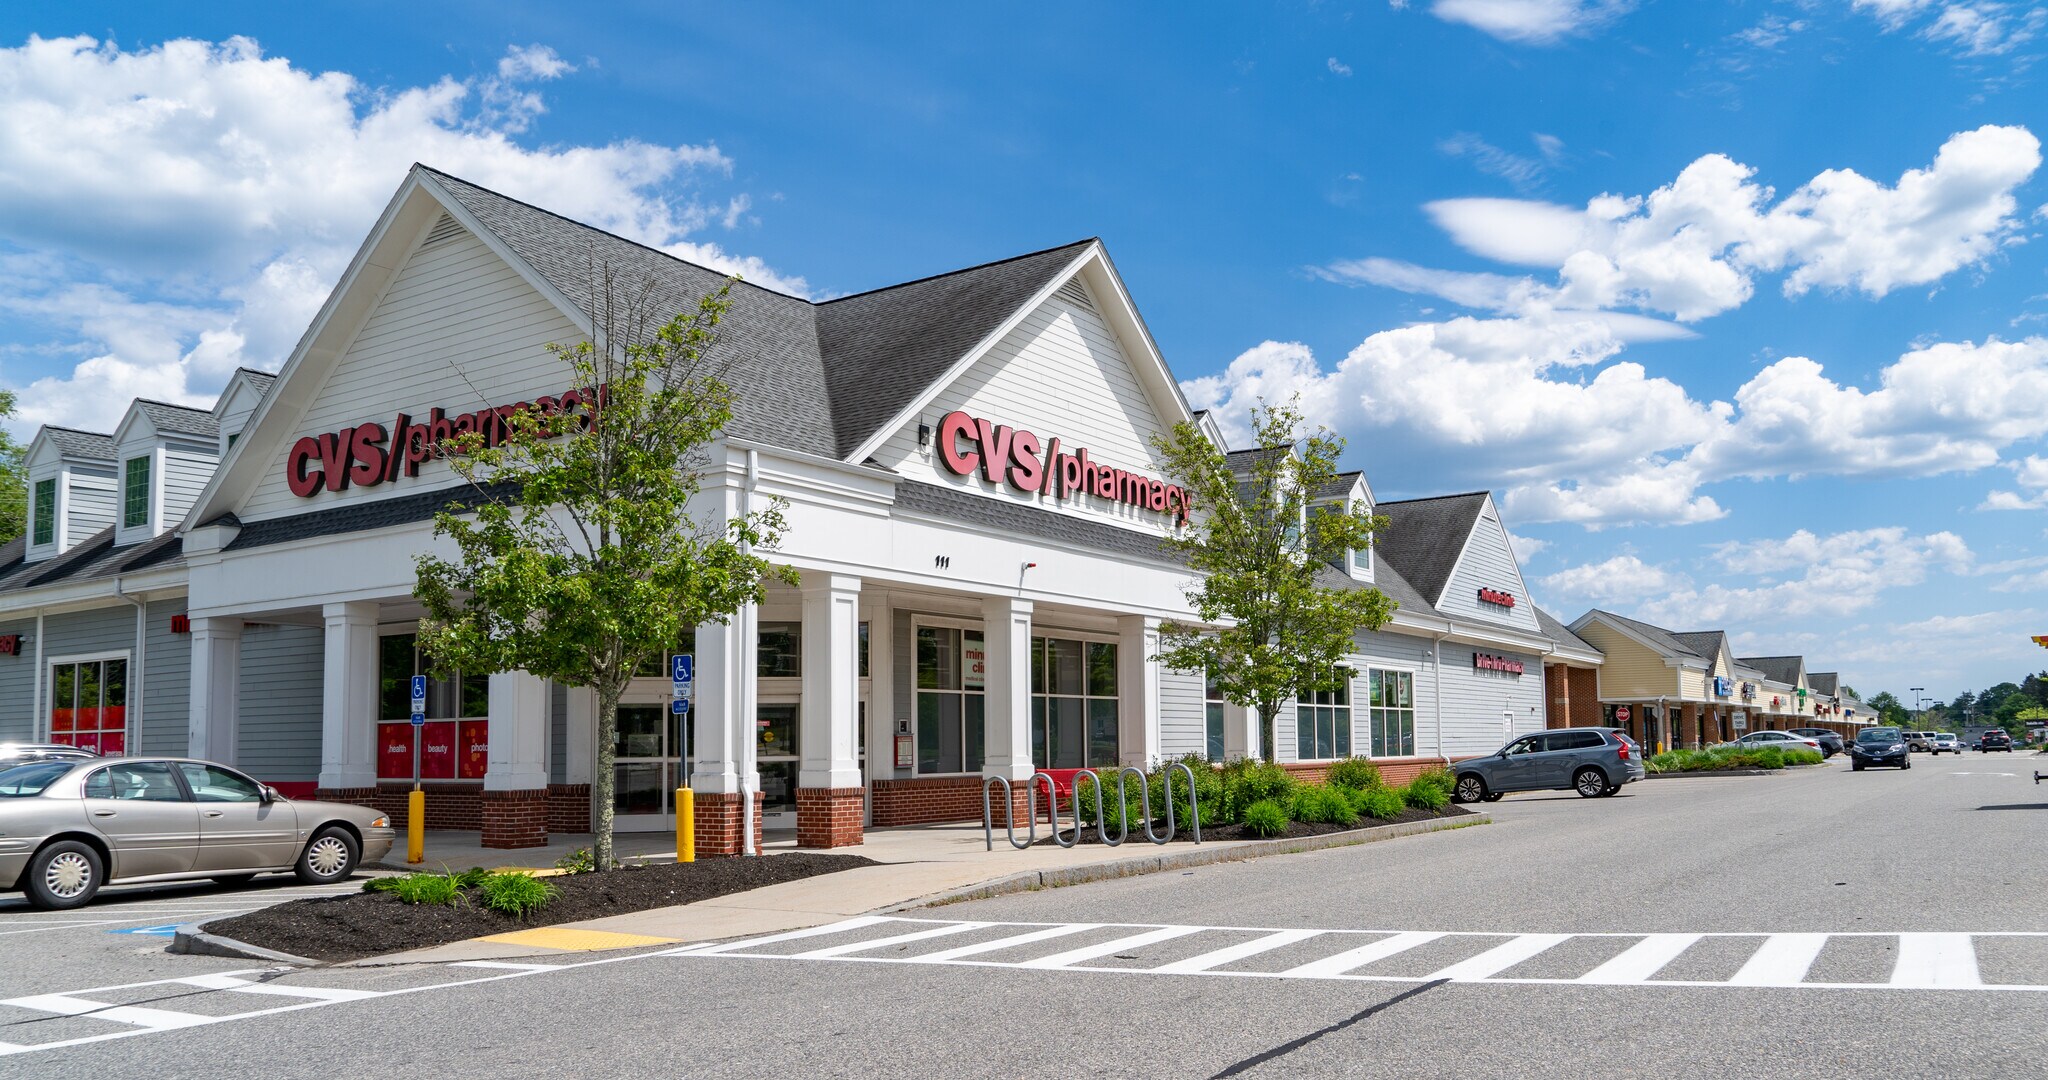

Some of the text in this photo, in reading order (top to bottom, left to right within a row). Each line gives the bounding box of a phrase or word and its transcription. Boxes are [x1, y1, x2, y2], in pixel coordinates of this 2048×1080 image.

[936, 411, 1192, 527] CVS/pharmacy
[935, 555, 950, 570] 111
[389, 744, 406, 752] health
[428, 744, 448, 754] beauty
